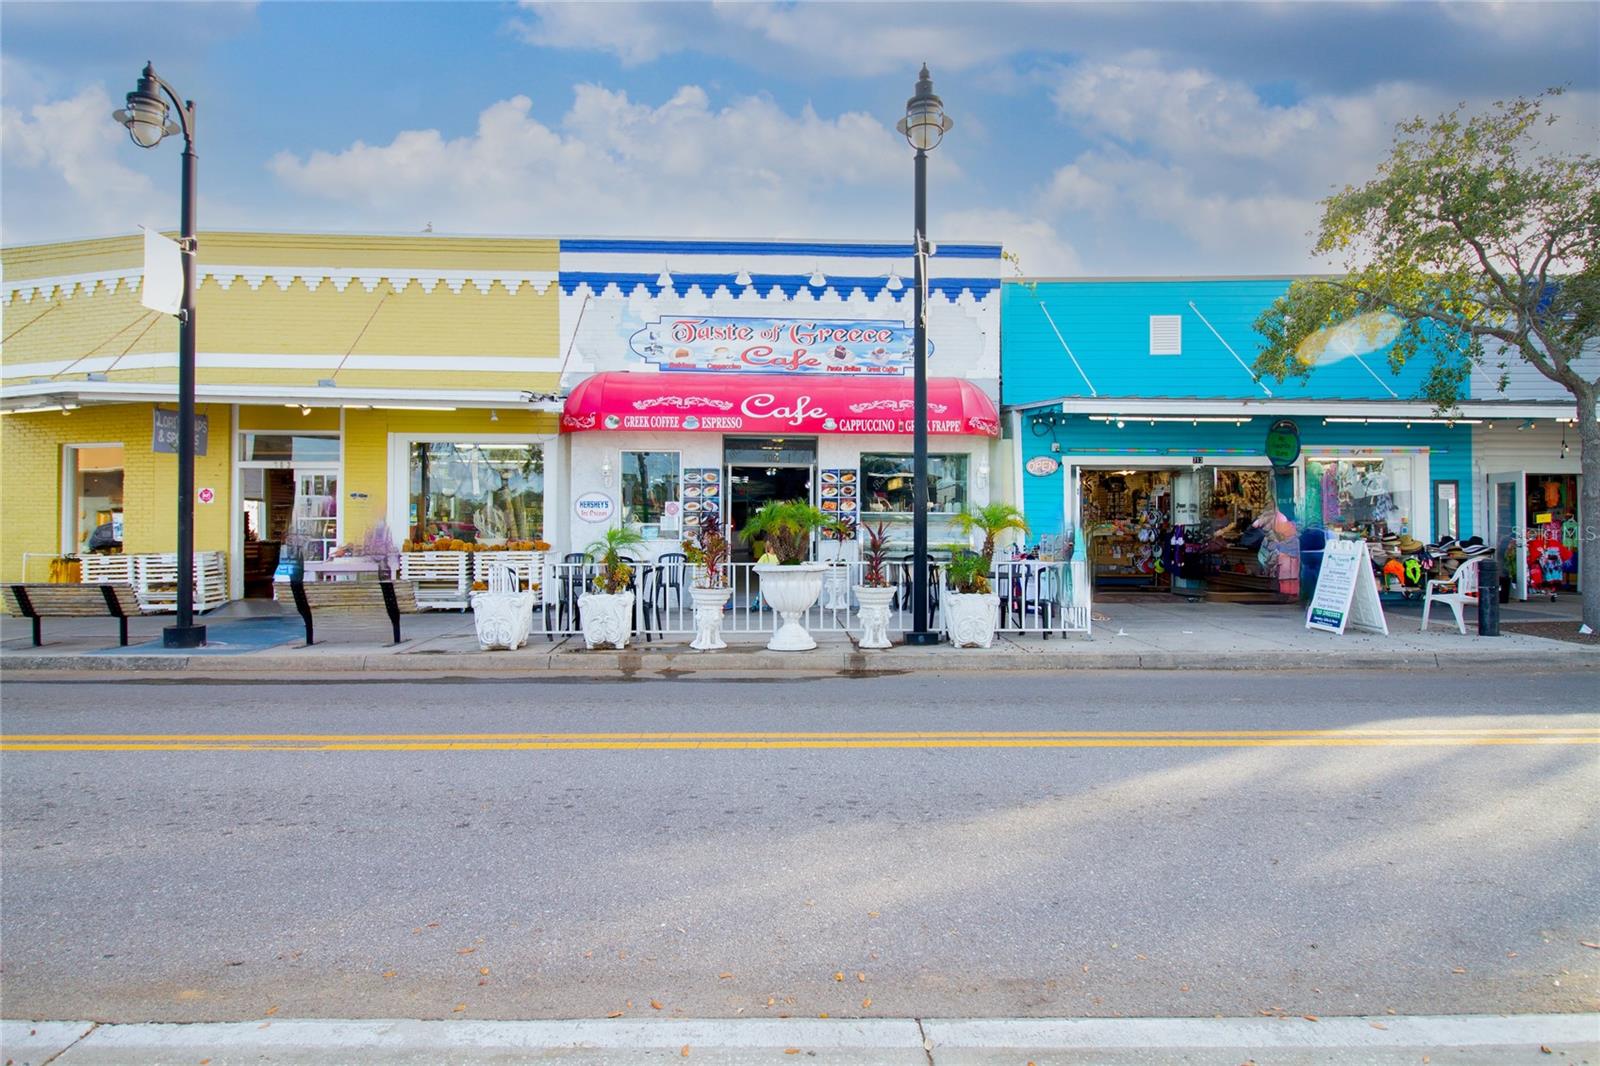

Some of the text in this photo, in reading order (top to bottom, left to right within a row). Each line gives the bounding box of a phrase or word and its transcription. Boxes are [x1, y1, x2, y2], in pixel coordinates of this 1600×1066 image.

[672, 319, 893, 346] Taste of Greece
[741, 345, 822, 371] Cafe
[740, 393, 828, 426] Cafe
[624, 416, 650, 428] GREEK
[651, 416, 680, 428] COFFEE
[702, 417, 743, 429] ESPRESSO
[839, 419, 896, 431] CAPPUCCINO
